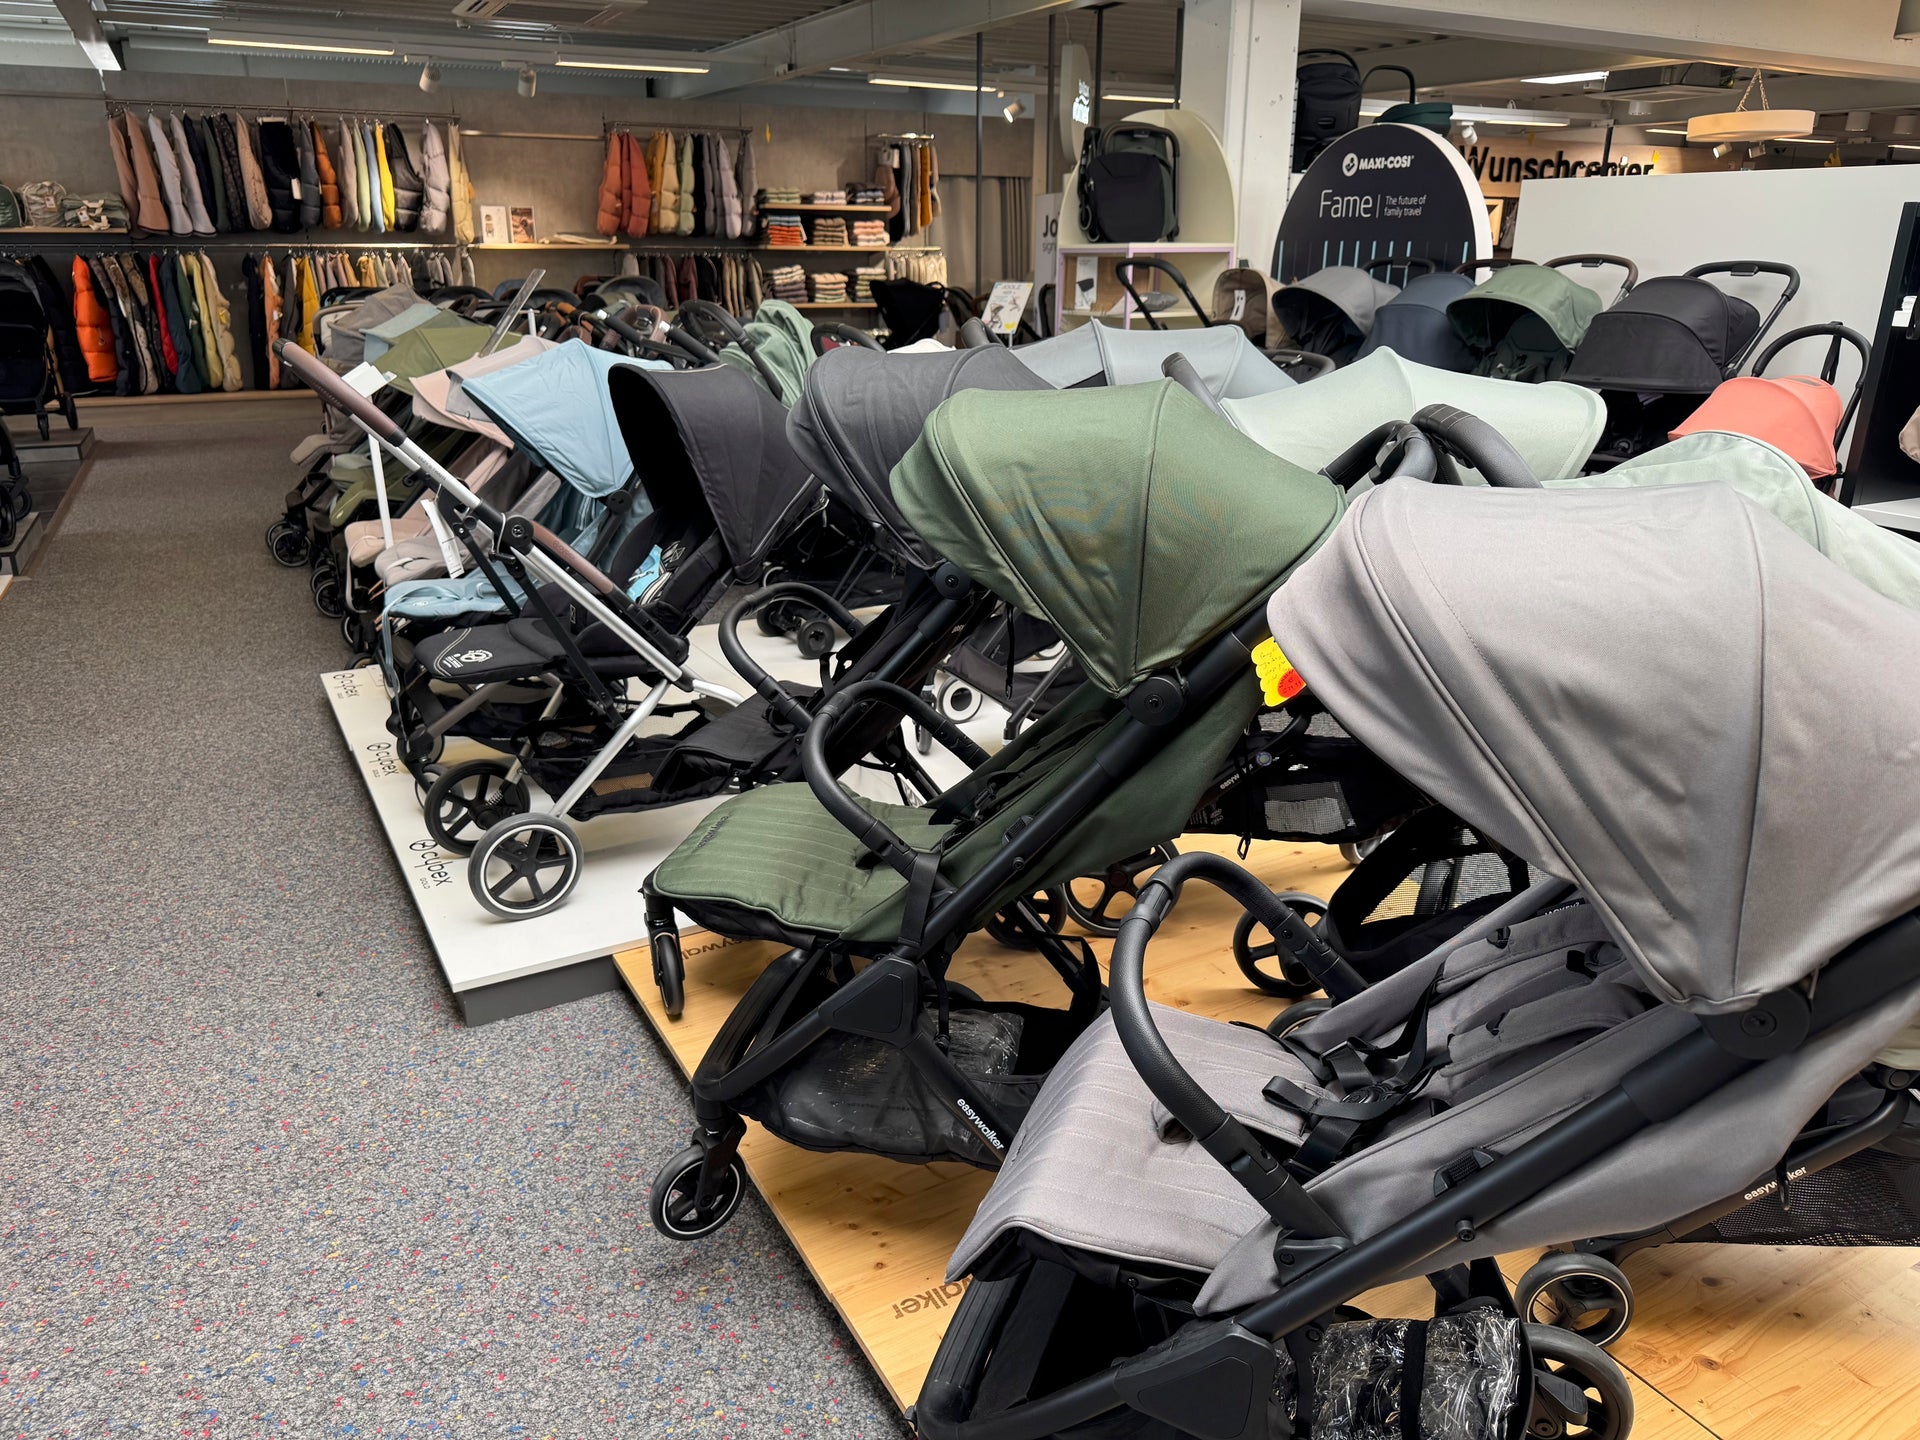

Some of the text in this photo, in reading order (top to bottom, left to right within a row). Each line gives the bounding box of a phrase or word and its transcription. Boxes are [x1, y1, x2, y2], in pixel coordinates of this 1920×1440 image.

[1320, 190, 1373, 218] Fame
[1384, 206, 1402, 218] family
[1385, 194, 1427, 206] The future of
[414, 851, 454, 887] cybex
[957, 1098, 1005, 1150] easywalker
[1743, 1166, 1807, 1200] easywlker
